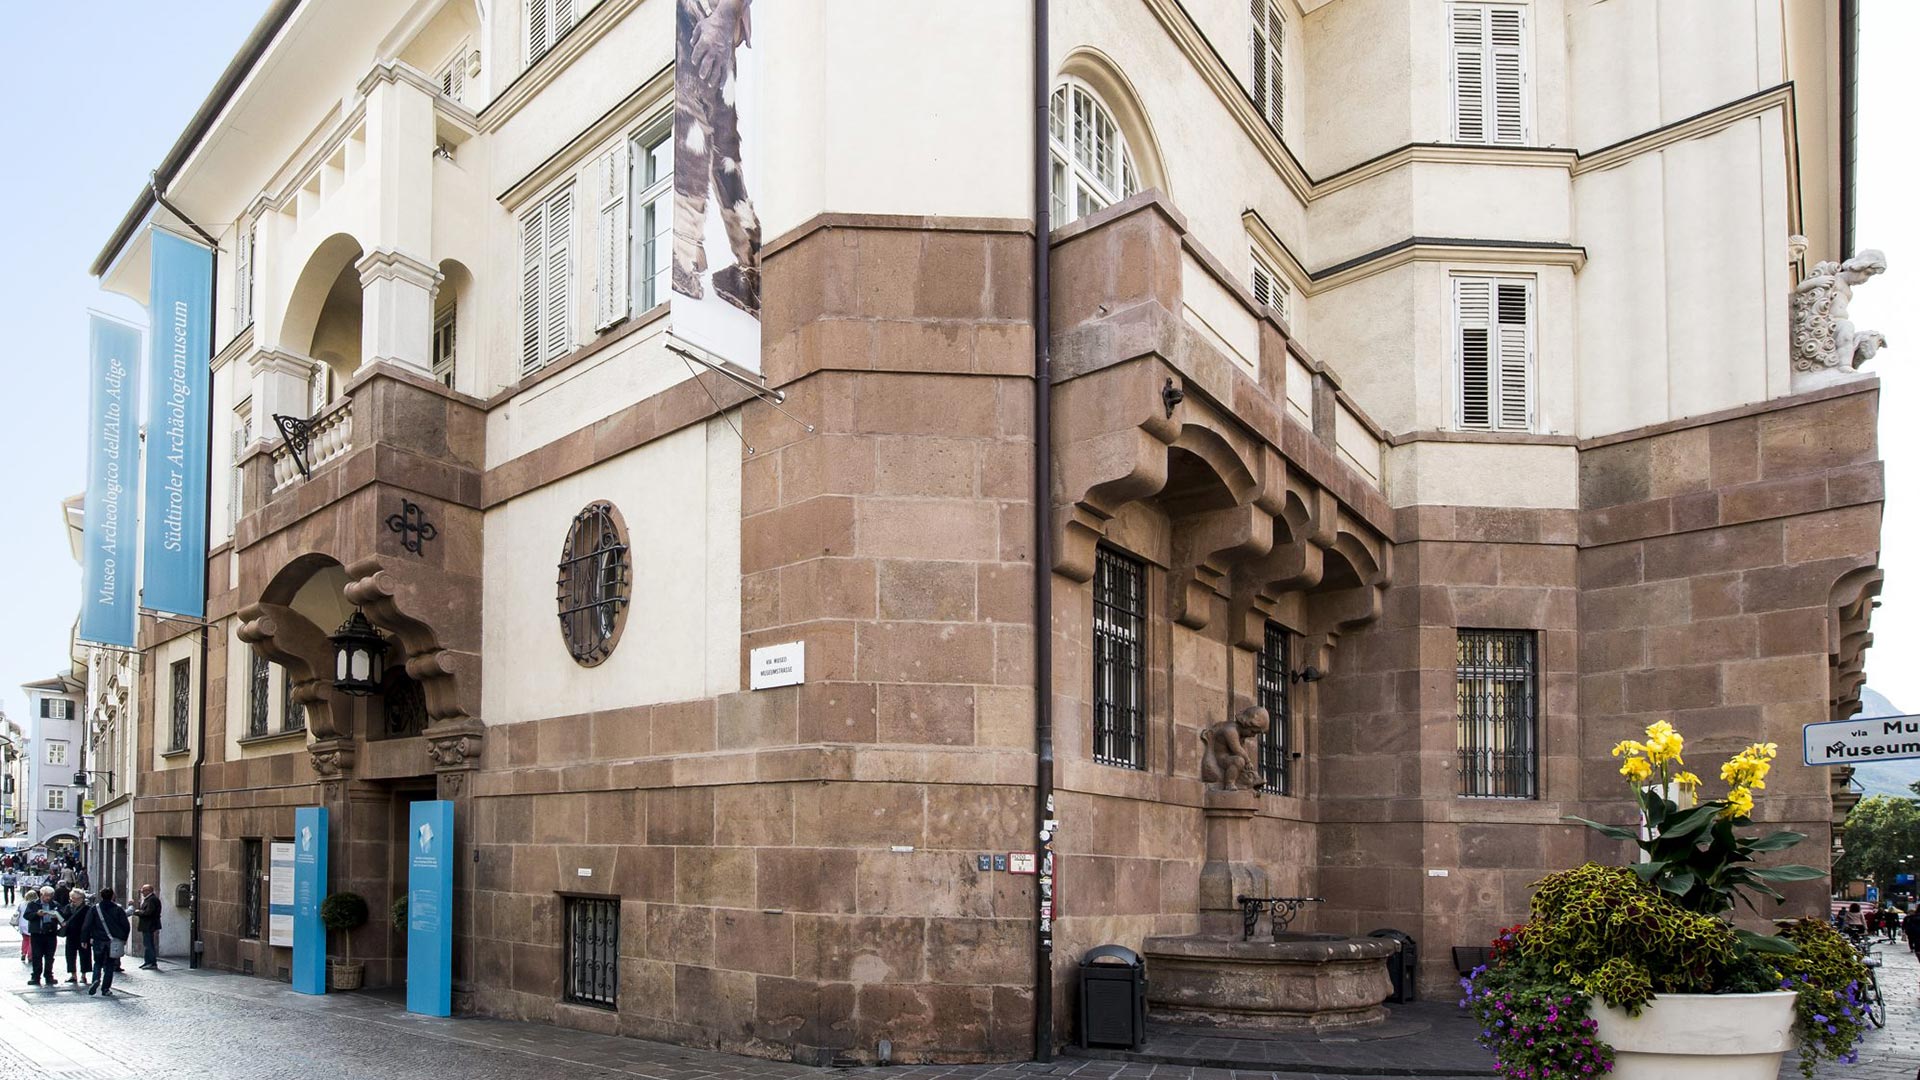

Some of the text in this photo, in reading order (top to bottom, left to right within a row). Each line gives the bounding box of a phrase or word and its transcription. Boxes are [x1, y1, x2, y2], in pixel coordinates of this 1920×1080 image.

[105, 358, 126, 400] Adige
[163, 301, 190, 552] Südtiroler Archäologiemuseum
[101, 461, 123, 556] Archeologico
[99, 559, 116, 606] Museo
[760, 666, 792, 676] MUSEUMSTRASSE
